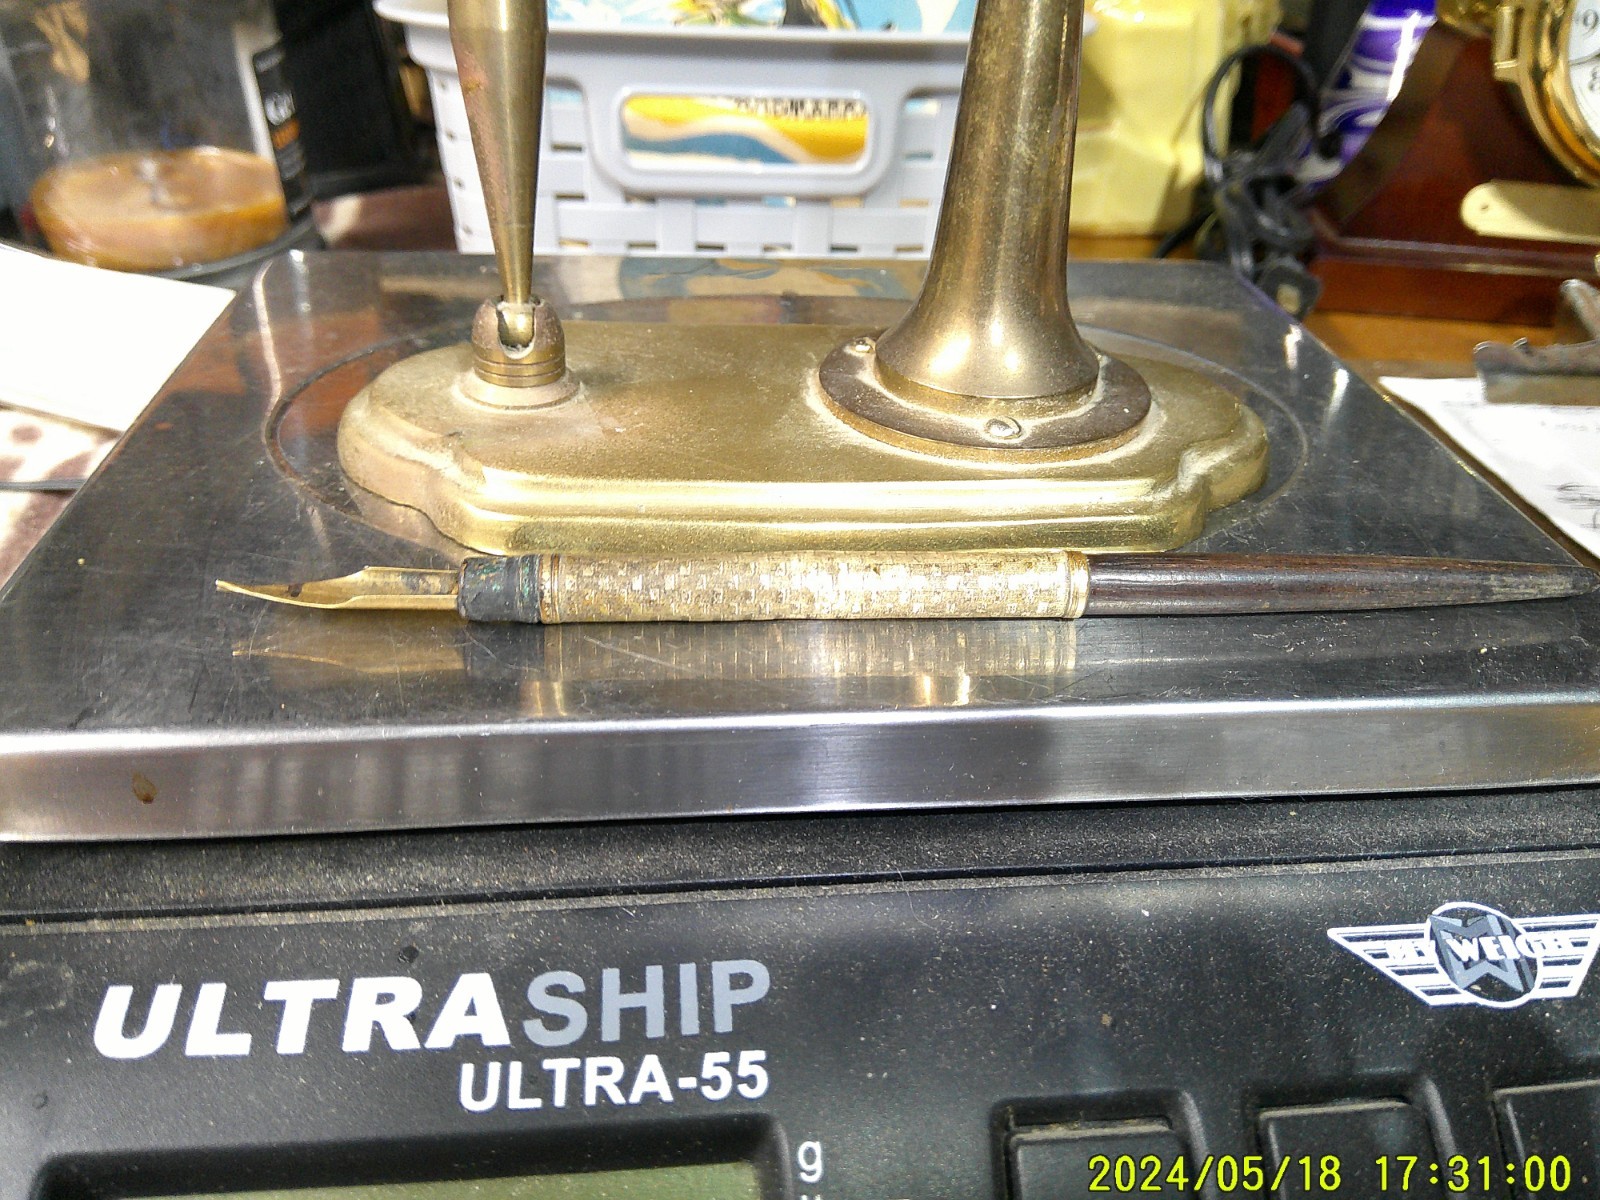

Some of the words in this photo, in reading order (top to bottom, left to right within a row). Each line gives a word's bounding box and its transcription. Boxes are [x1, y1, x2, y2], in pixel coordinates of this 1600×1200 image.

[93, 959, 770, 1059] ULTRASHIP
[460, 1050, 769, 1112] ULTRA-55
[798, 1141, 822, 1183] g
